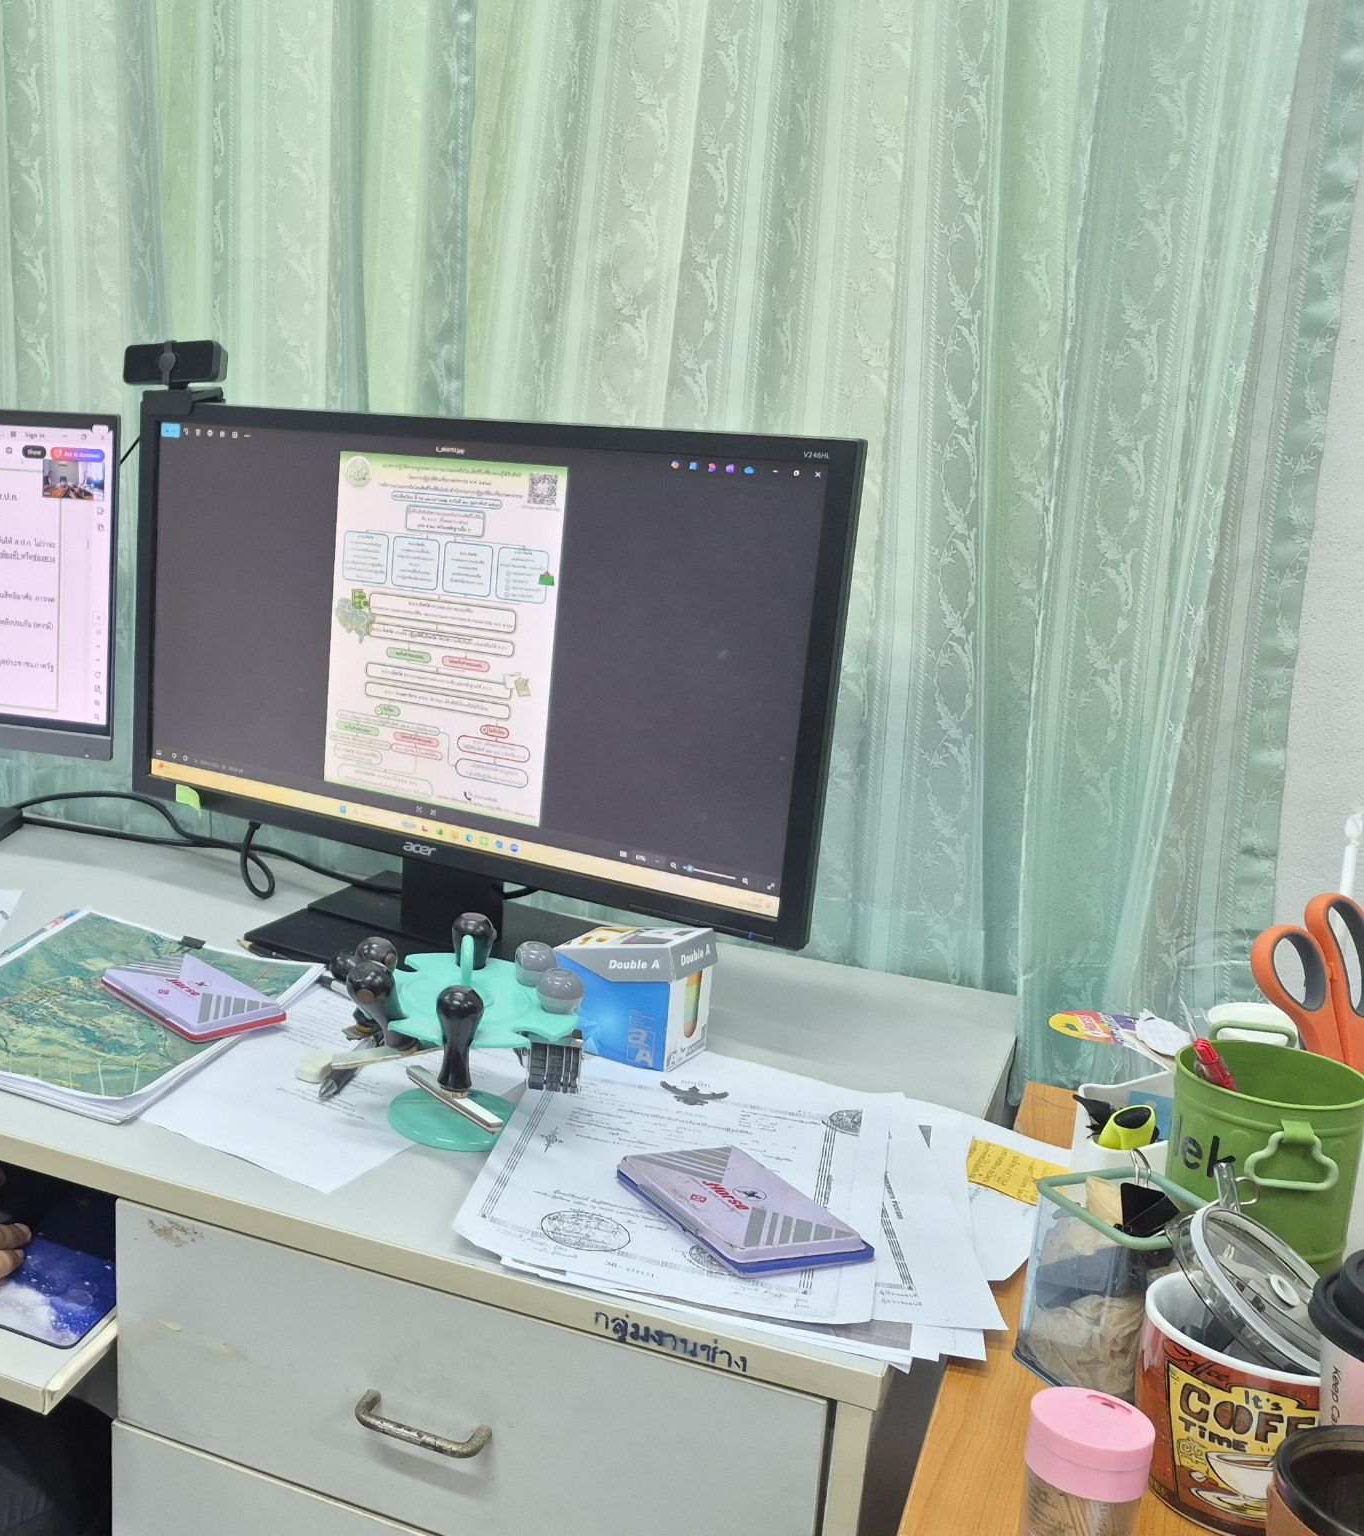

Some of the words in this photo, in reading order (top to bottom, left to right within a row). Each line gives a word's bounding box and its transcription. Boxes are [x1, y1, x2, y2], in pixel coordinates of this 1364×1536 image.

[803, 451, 830, 460] V246HL
[402, 841, 436, 856] acer
[609, 960, 647, 970] Double
[651, 960, 660, 969] A
[680, 948, 703, 966] Double
[701, 1180, 750, 1210] Horse
[594, 1312, 747, 1373] กลุ่มงานช่าง
[1330, 1365, 1342, 1403] Keep
[1244, 1389, 1283, 1412] It's
[1330, 1405, 1341, 1427] Ca
